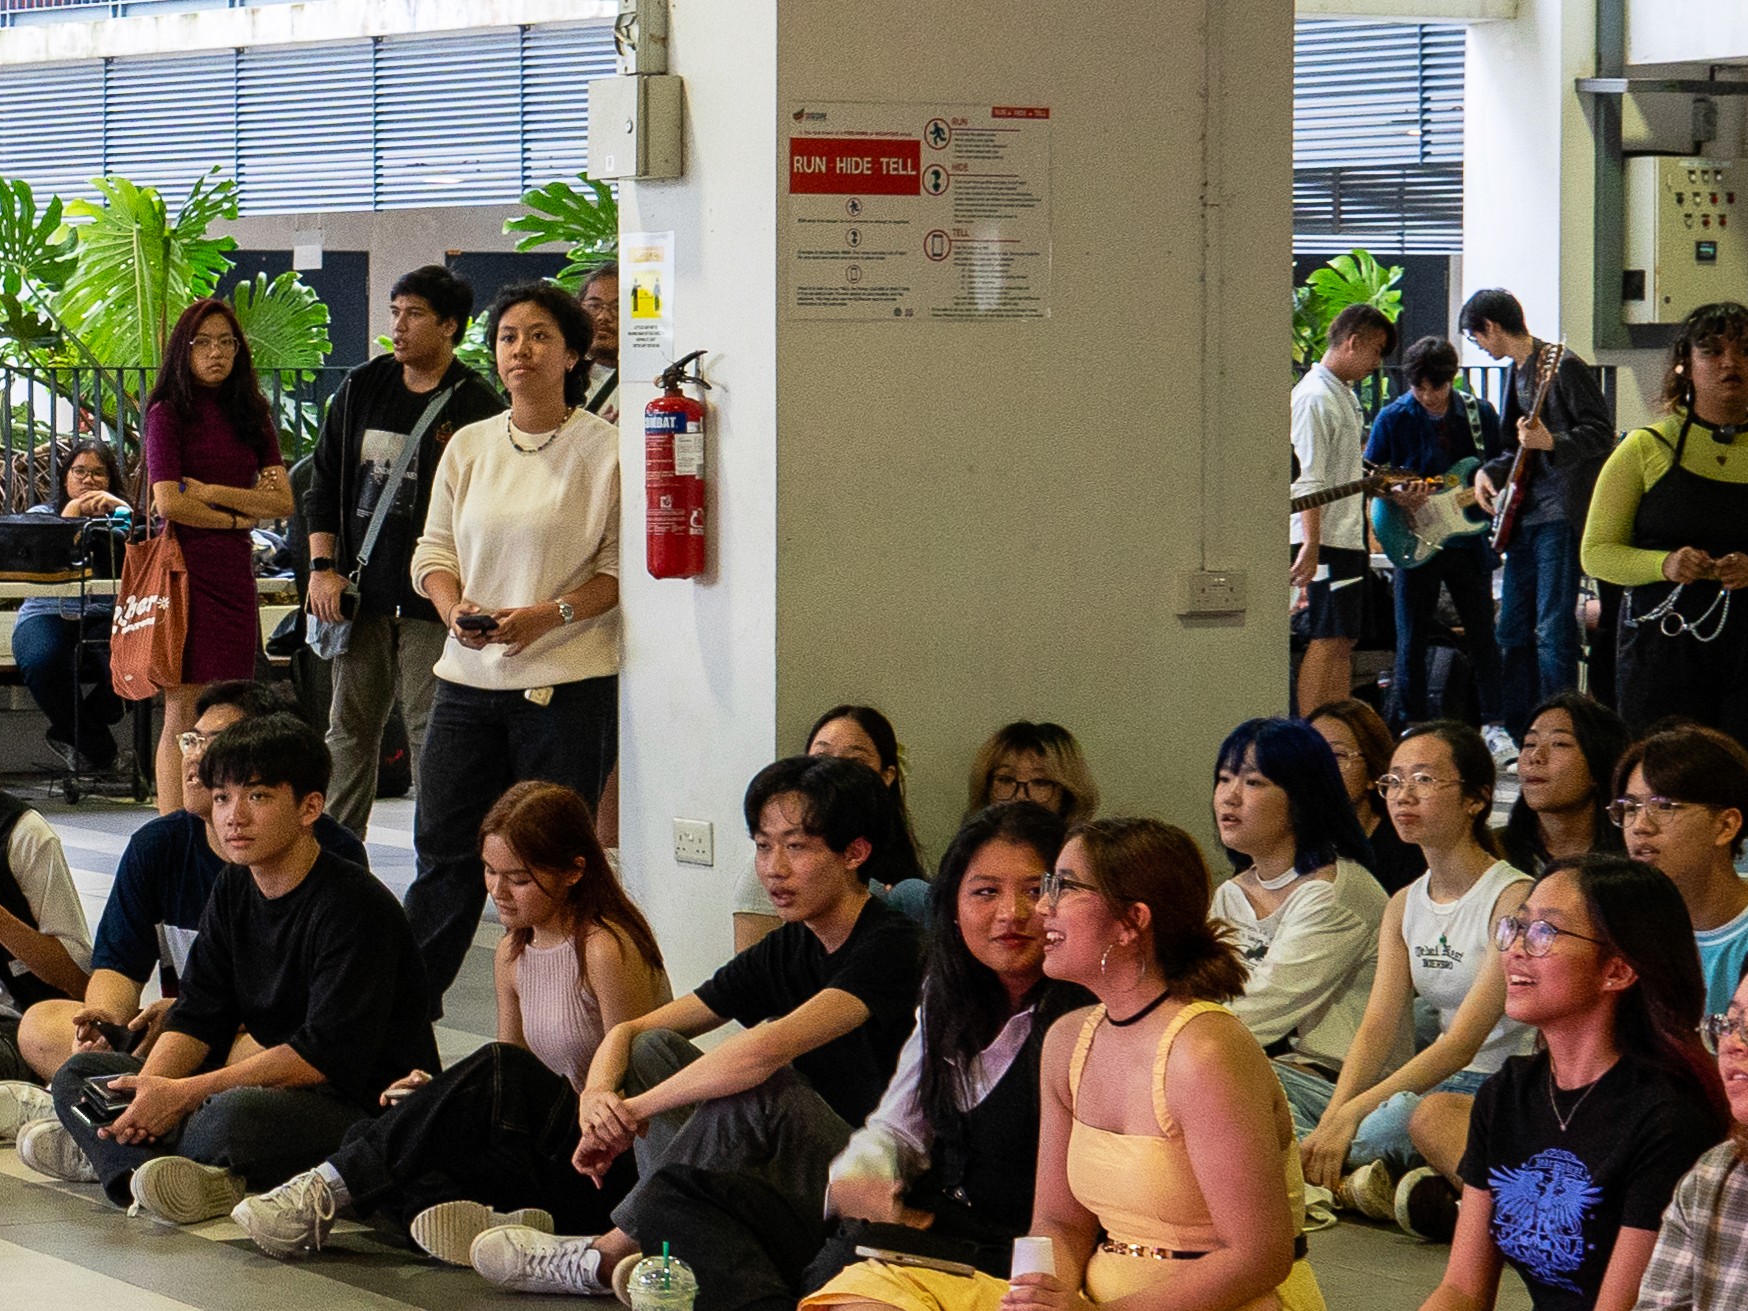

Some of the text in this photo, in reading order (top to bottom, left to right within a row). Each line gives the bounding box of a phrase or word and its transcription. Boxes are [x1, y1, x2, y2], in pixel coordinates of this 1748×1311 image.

[951, 117, 968, 126] RUN
[793, 155, 917, 176] RUN HIDE TELL
[951, 228, 970, 238] TELL
